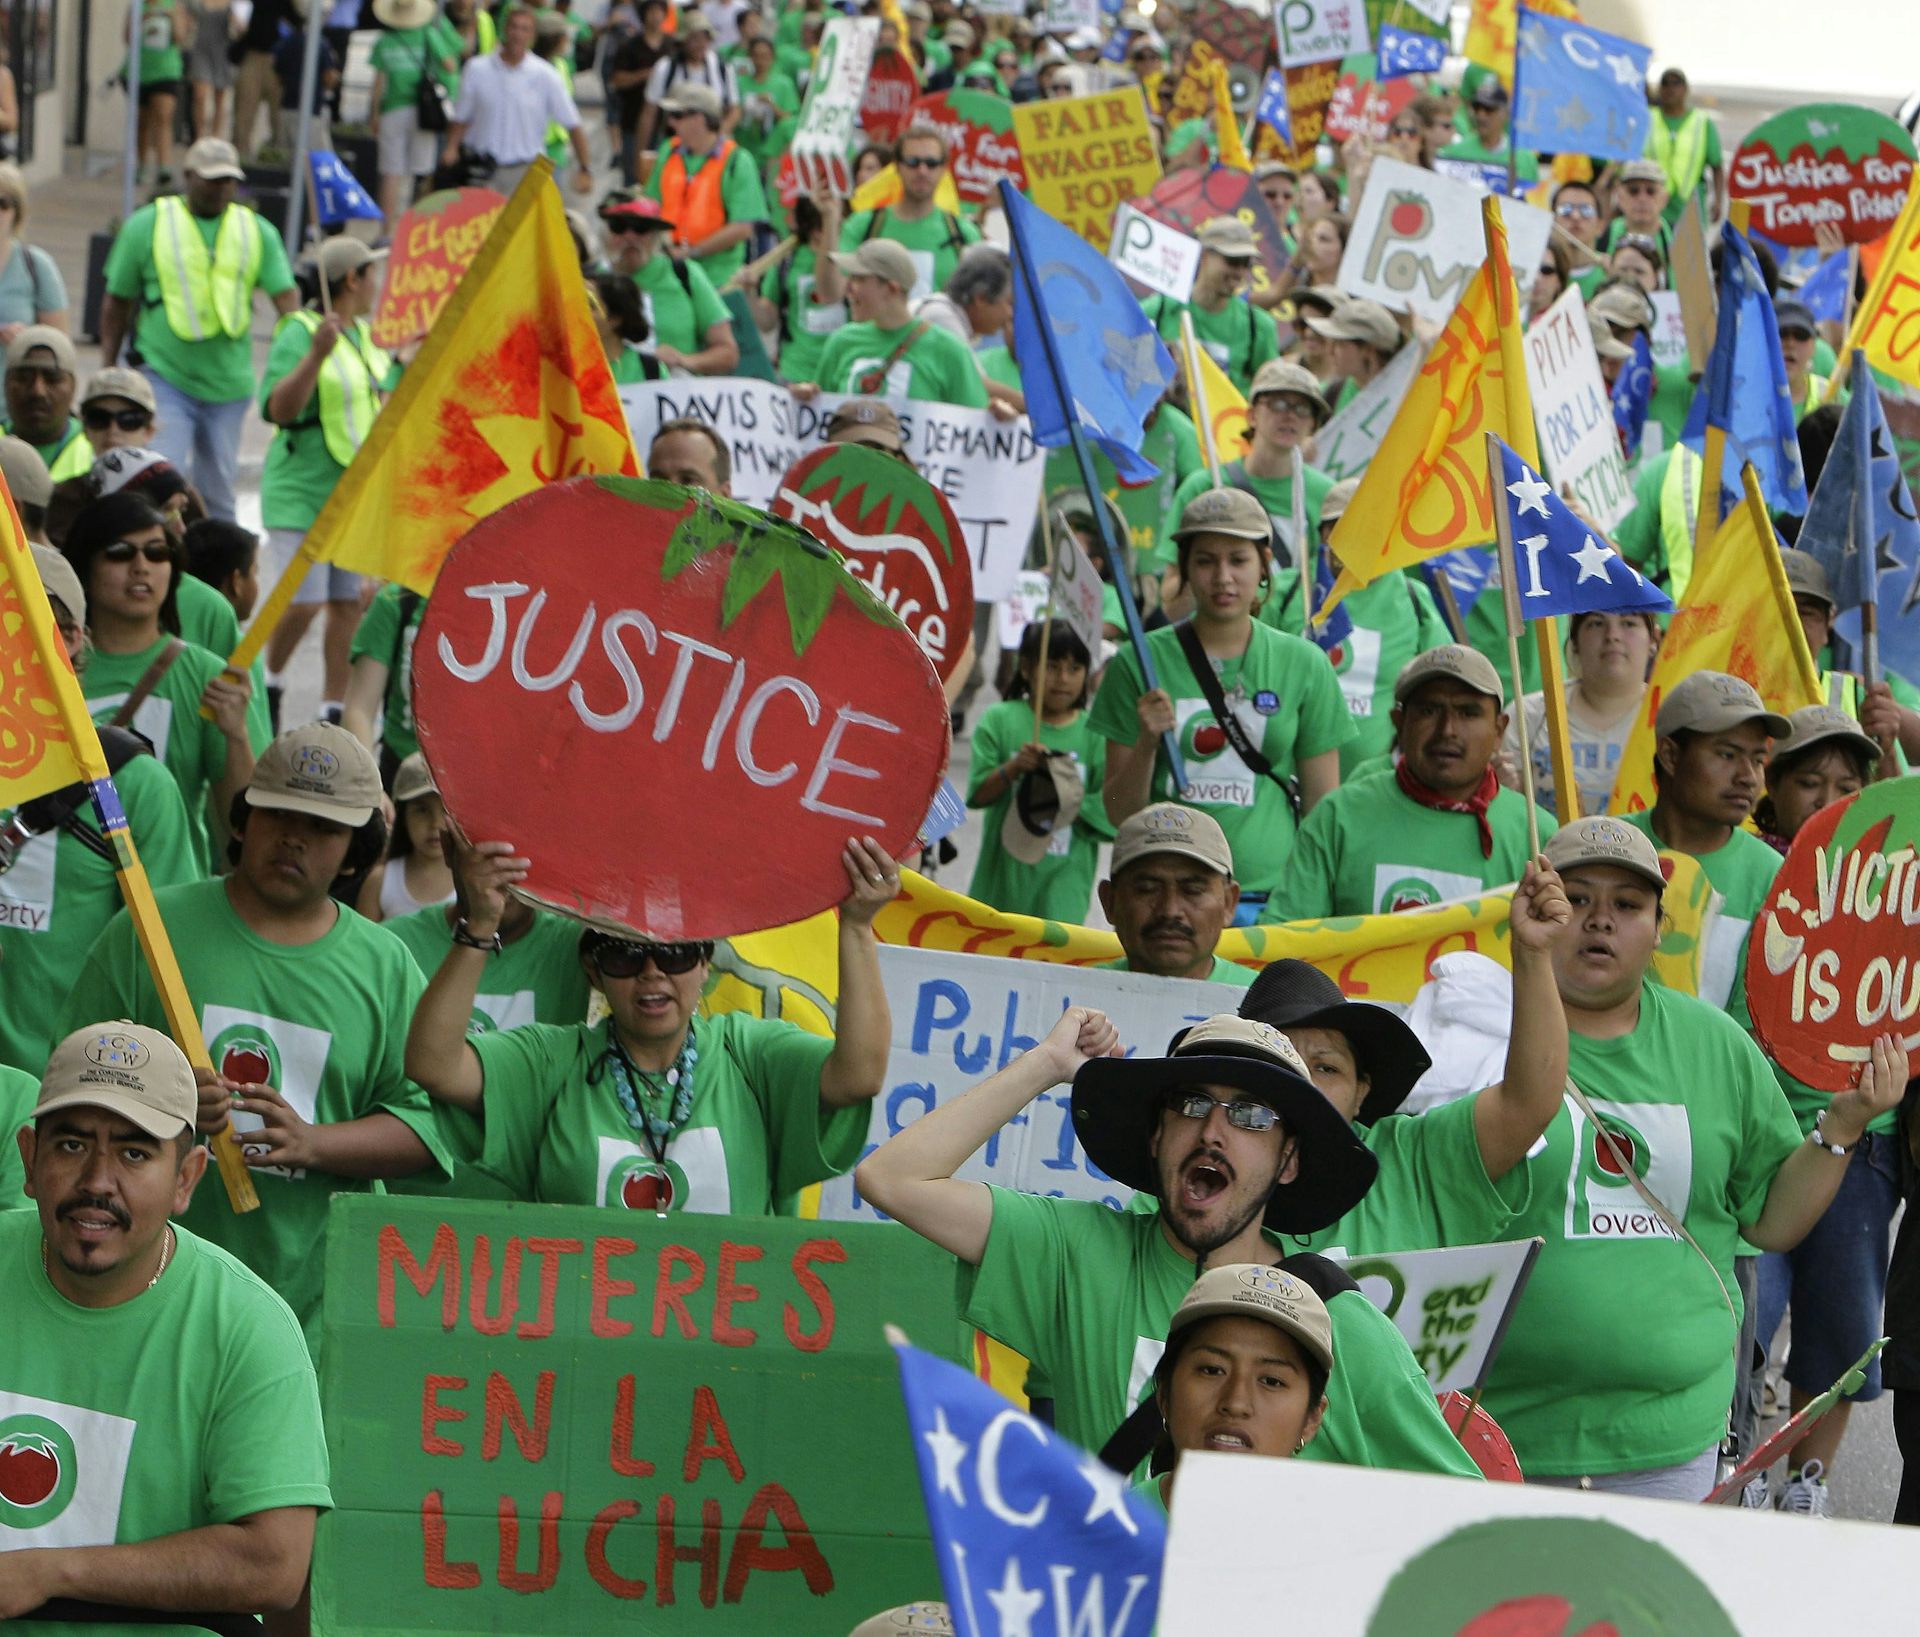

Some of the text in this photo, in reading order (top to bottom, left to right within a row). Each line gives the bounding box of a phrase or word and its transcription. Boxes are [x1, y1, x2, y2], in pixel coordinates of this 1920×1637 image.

[1032, 98, 1134, 140] FAIR
[1026, 136, 1153, 179] WAGES
[1735, 152, 1913, 189] Justice For
[1061, 176, 1136, 212] FOR
[1749, 194, 1846, 230] Tomato
[1532, 311, 1582, 389] PITA
[656, 390, 758, 432] DAVIS
[924, 417, 1039, 466] DEMAND
[1545, 384, 1605, 464] POR LA
[1573, 443, 1629, 520] STICIA
[1516, 533, 1550, 598] I
[438, 582, 902, 828] JUSTICE
[1791, 949, 1841, 1024] IS
[96, 1048, 139, 1067] I W
[111, 1036, 126, 1049] C
[378, 1223, 848, 1353] MUJERES
[1252, 1276, 1295, 1297] I W
[1266, 1269, 1280, 1281] C
[1422, 1273, 1496, 1313] end
[1422, 1312, 1477, 1339] the
[421, 1371, 745, 1483] EN LA
[976, 1408, 1049, 1529] C
[421, 1483, 834, 1609] LUCHA
